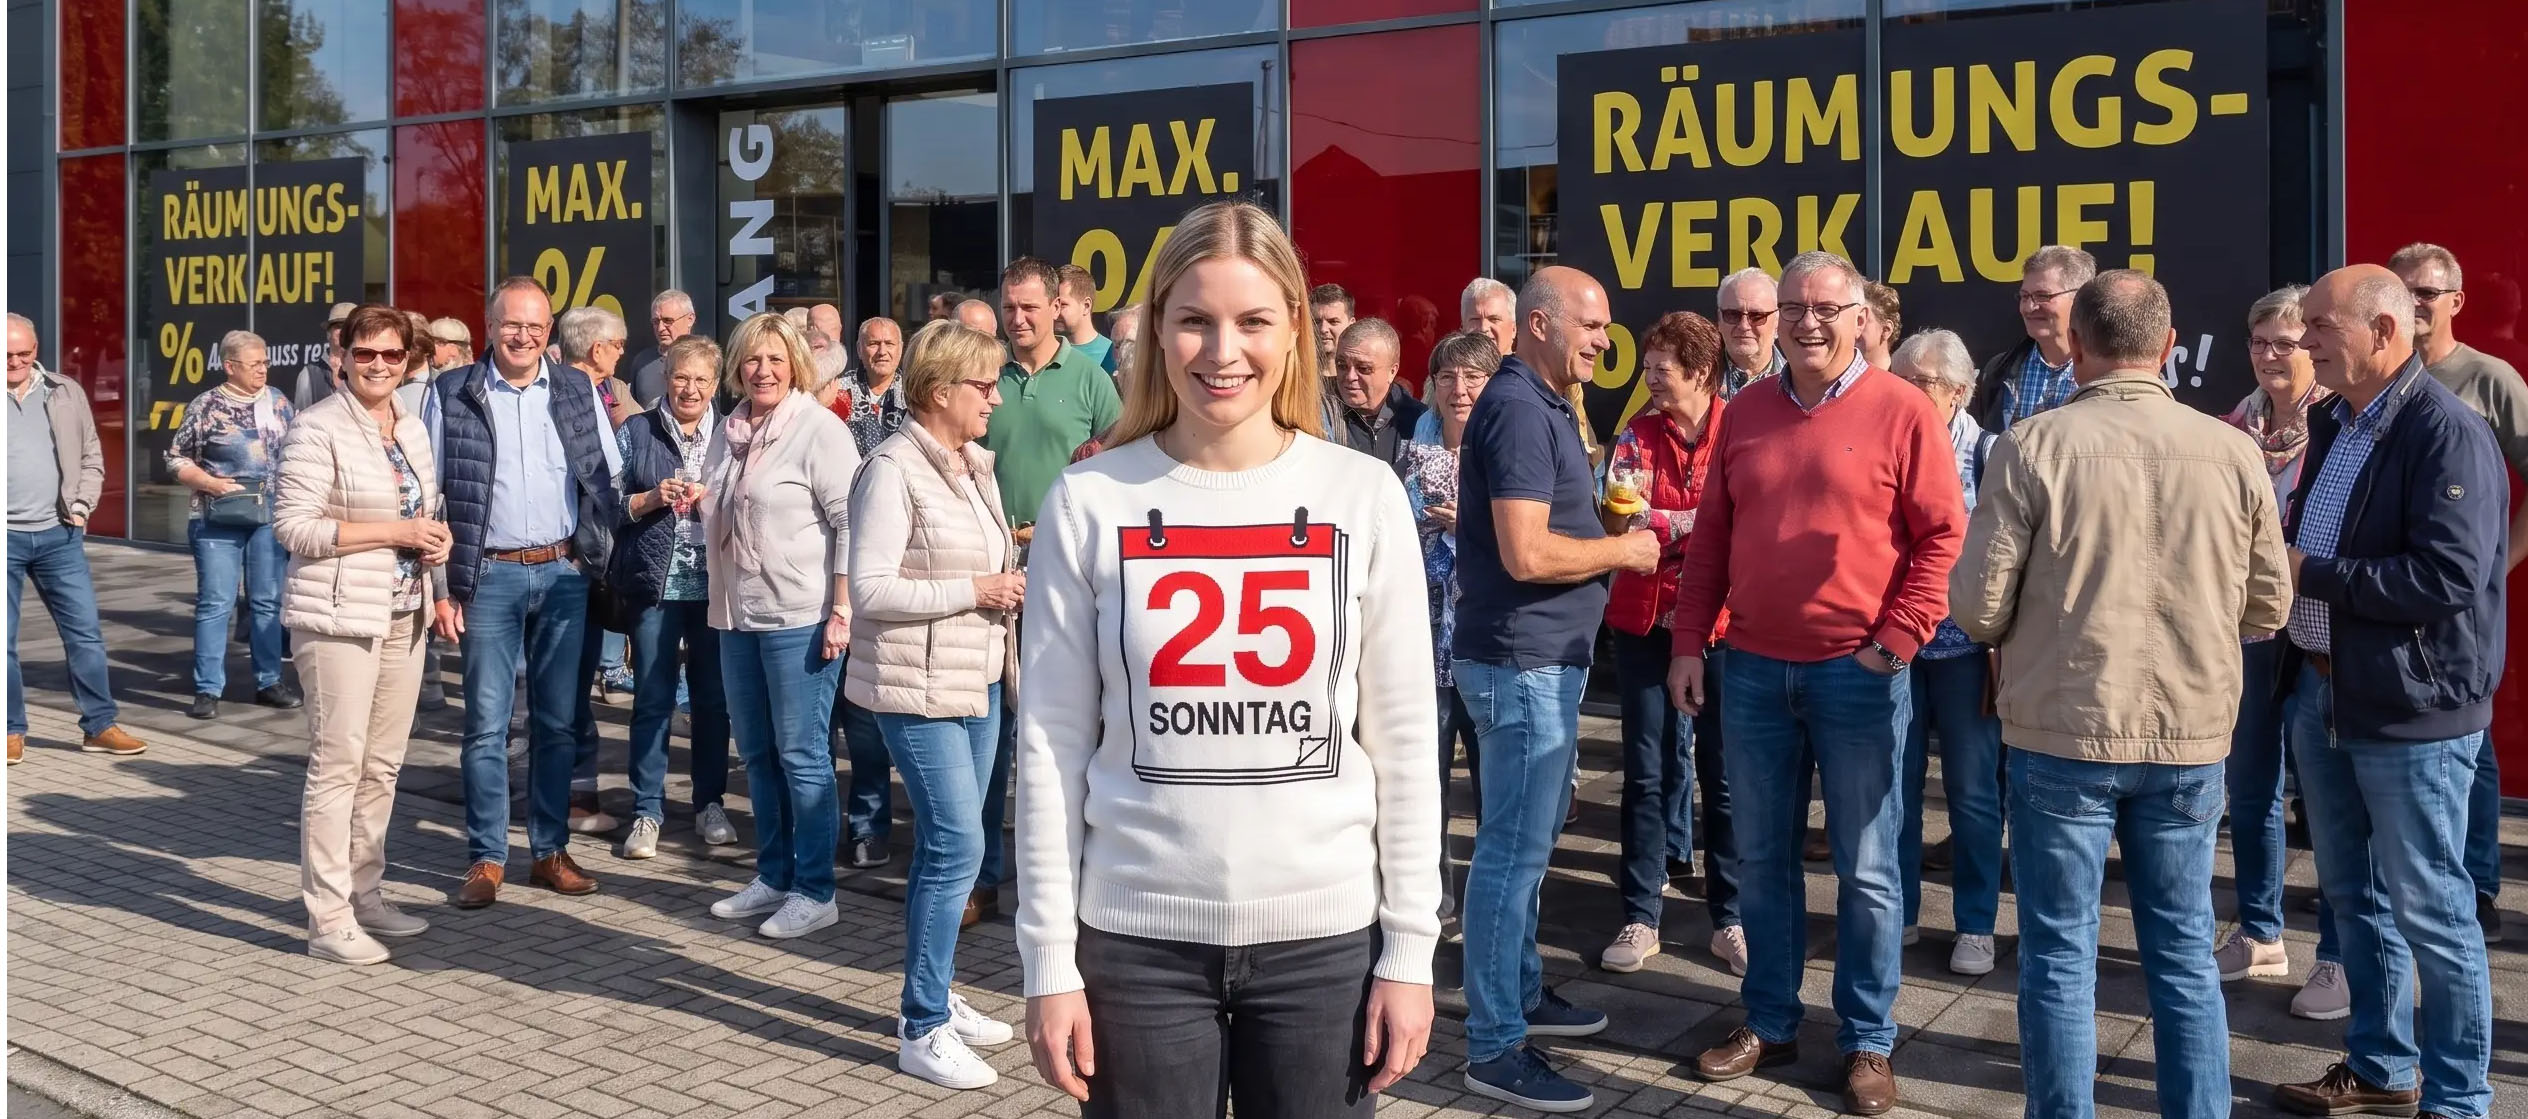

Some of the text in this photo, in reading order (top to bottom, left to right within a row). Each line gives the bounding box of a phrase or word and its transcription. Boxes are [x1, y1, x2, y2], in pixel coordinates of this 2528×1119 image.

[1060, 118, 1239, 200] MAX.
[526, 160, 642, 225] MAX.
[160, 321, 204, 385] %
[1146, 570, 1316, 687] 25
[1149, 700, 1312, 736] SONNTAG
